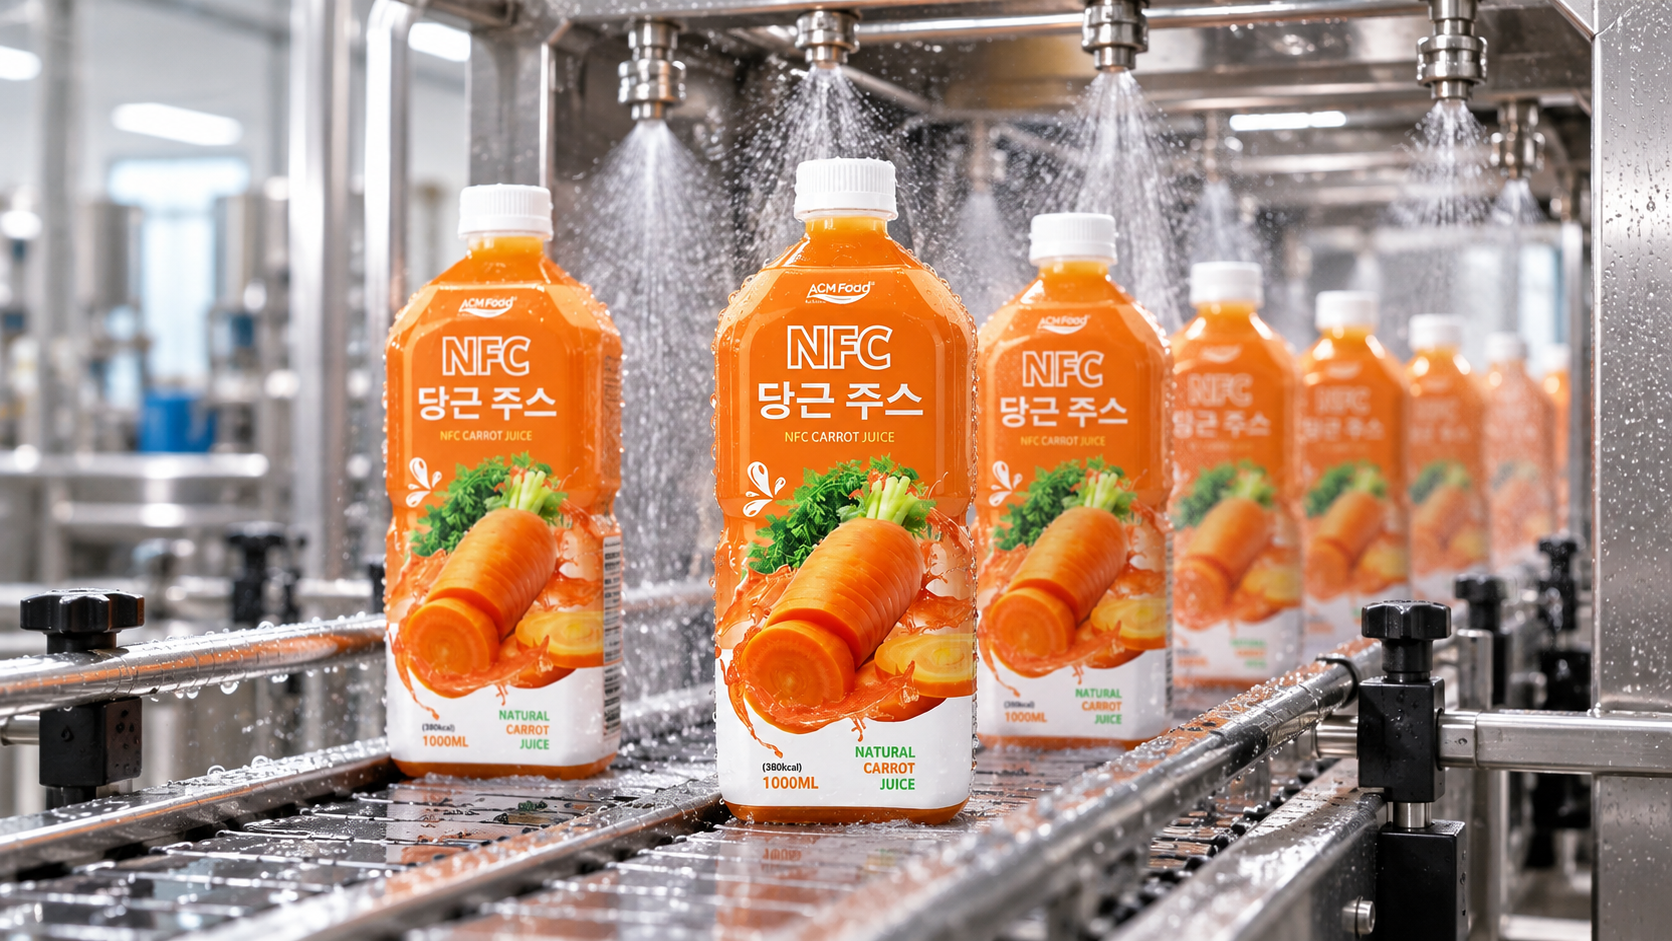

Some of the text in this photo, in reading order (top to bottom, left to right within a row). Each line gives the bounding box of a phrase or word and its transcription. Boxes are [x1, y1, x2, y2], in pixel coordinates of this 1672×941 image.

[806, 283, 836, 298] ACM
[787, 325, 893, 370] NFC
[442, 335, 531, 376] NFC
[1022, 350, 1105, 388] NFC
[418, 386, 557, 421] 당근 주스
[758, 381, 924, 421] 당근 주스
[1000, 396, 1128, 428] 당근 주스
[440, 430, 532, 442] NFC CARROT JUICE
[784, 431, 895, 443] NFC CARROT JUICE
[1020, 435, 1106, 447] NFC CARROT JUICE
[1075, 688, 1123, 699] NATURAL
[1081, 701, 1123, 711] CARROT
[499, 709, 550, 721] NATURAL
[1004, 711, 1048, 723] 1000ML
[1094, 714, 1123, 724] JUICE
[506, 724, 550, 735] CARROT
[423, 735, 469, 748] 1000ML
[519, 738, 550, 750] JUICE
[855, 746, 916, 758] NATURAL
[762, 762, 803, 773] (380kcal)
[863, 762, 916, 774] CARROT
[762, 776, 819, 789] 1000ML
[879, 778, 916, 790] JUICE
